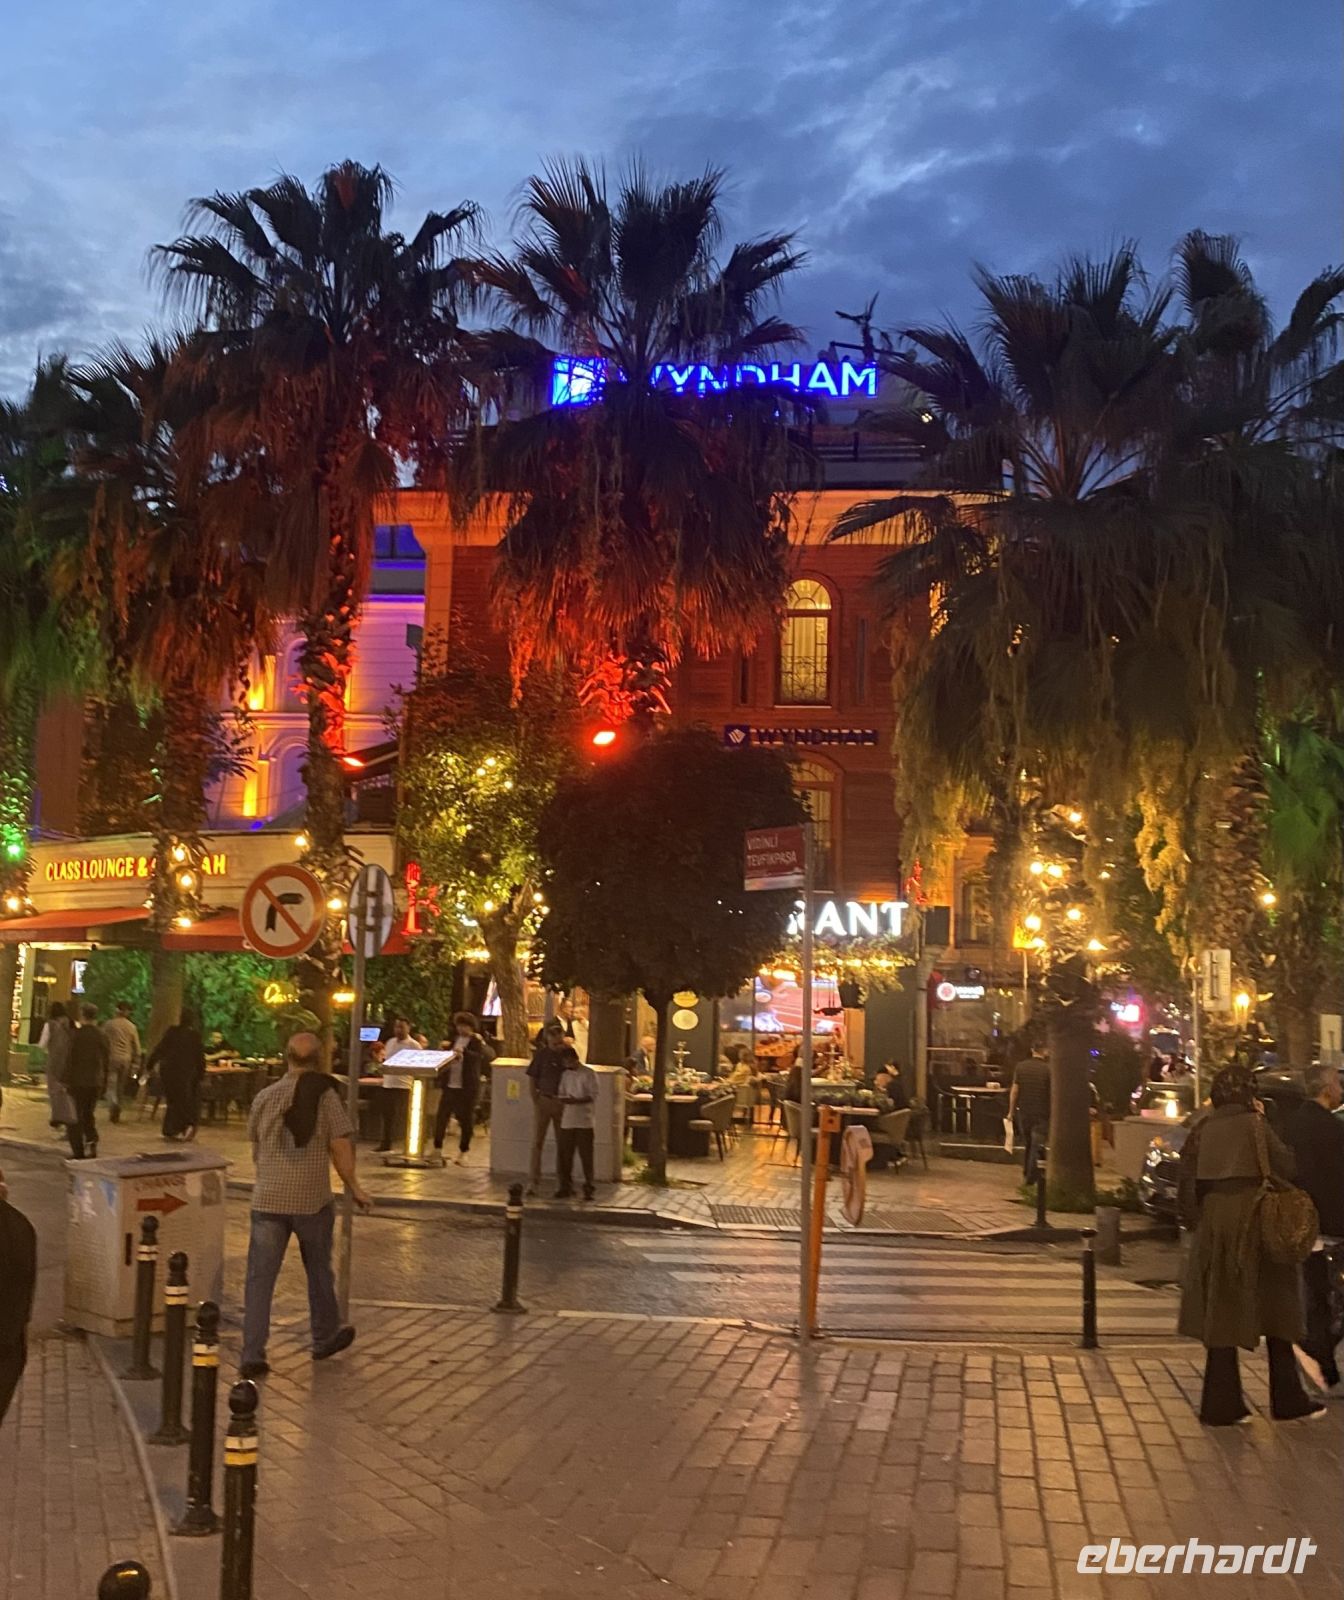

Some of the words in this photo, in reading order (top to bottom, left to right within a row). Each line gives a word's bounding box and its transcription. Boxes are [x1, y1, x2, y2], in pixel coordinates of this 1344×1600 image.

[620, 361, 877, 397] YNDHAM
[45, 861, 80, 881] CLASS
[82, 857, 134, 879] LOUNGE
[137, 857, 148, 877] &
